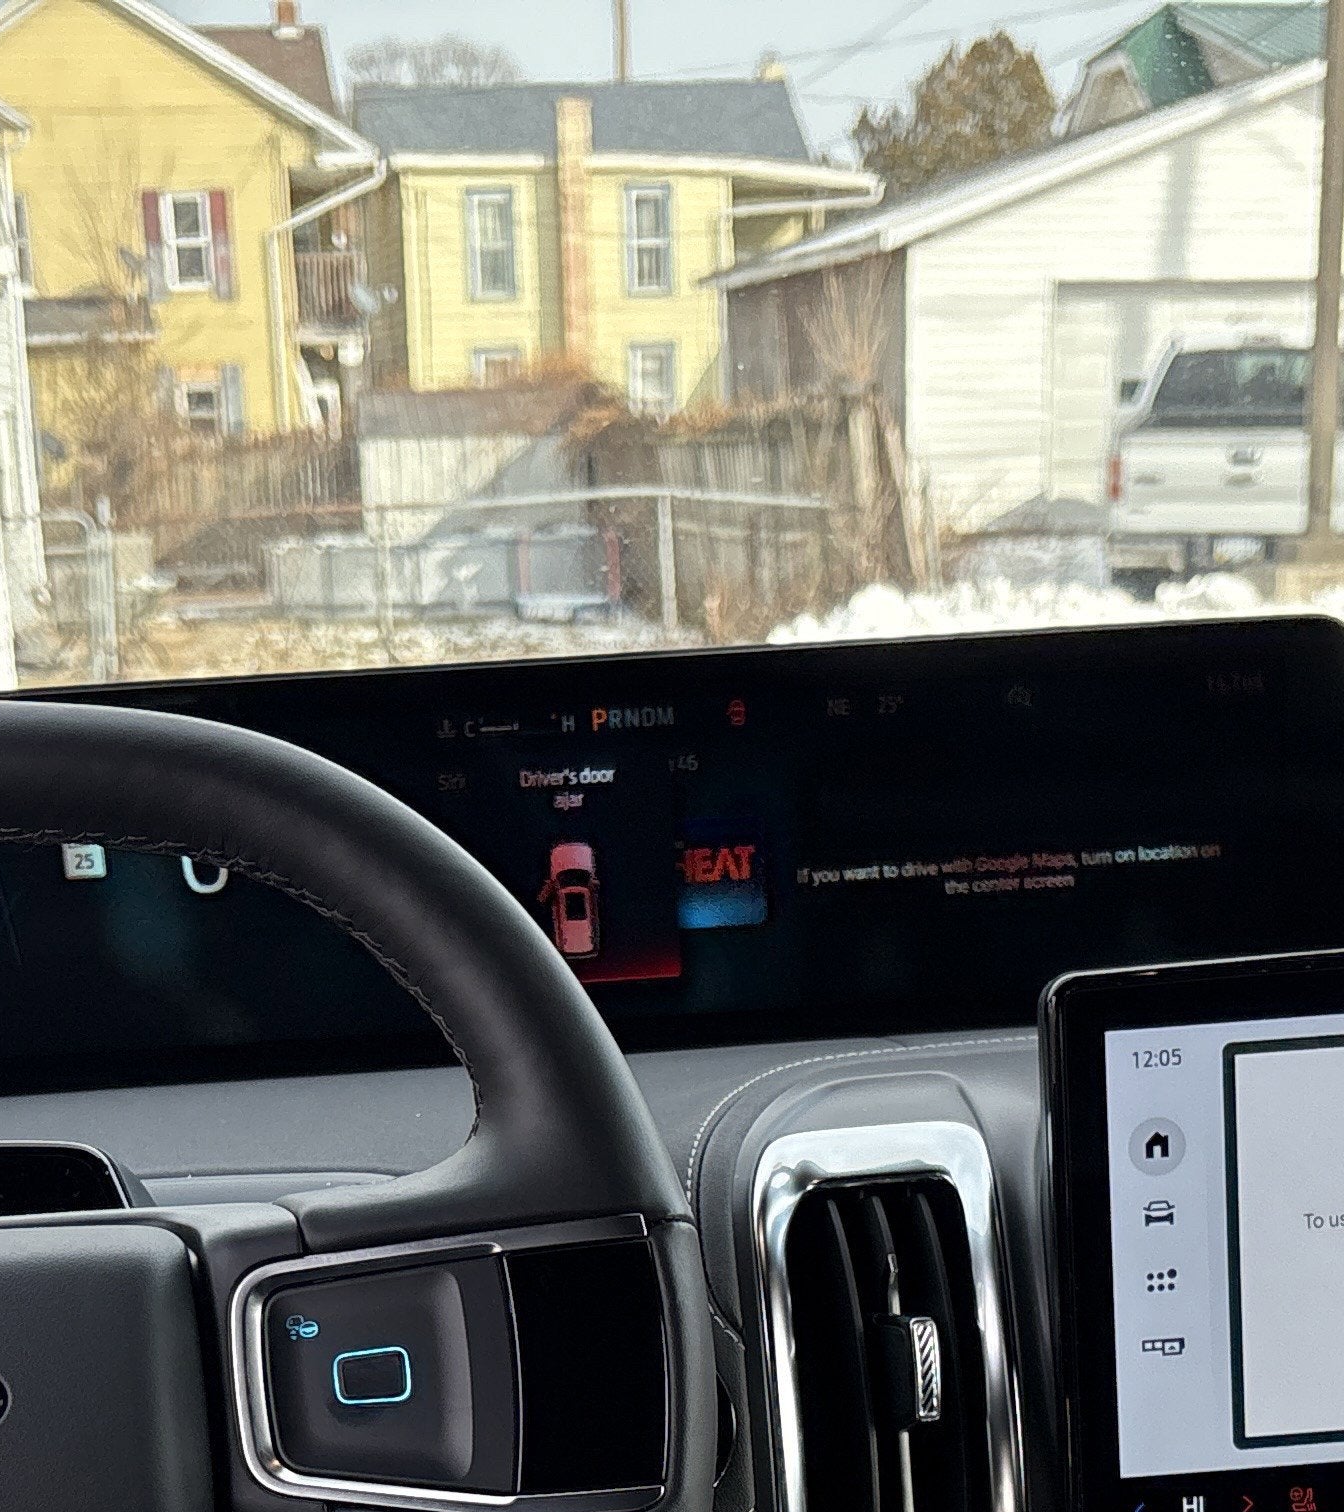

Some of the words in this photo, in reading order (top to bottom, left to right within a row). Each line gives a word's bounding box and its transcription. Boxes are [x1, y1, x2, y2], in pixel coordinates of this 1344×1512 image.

[518, 767, 578, 789] Driver's
[579, 766, 616, 784] door
[552, 791, 585, 811] ajar
[73, 852, 95, 871] 25
[812, 867, 840, 886] you
[843, 864, 880, 881] want
[883, 863, 899, 879] to
[902, 860, 938, 877] drive
[941, 856, 974, 875] with
[976, 854, 1029, 876] Google
[1081, 848, 1113, 865] turn
[1114, 847, 1136, 863] on
[1138, 843, 1198, 861] location
[944, 878, 970, 895] the
[1130, 1048, 1184, 1070] 12:05
[1302, 1211, 1325, 1230] To
